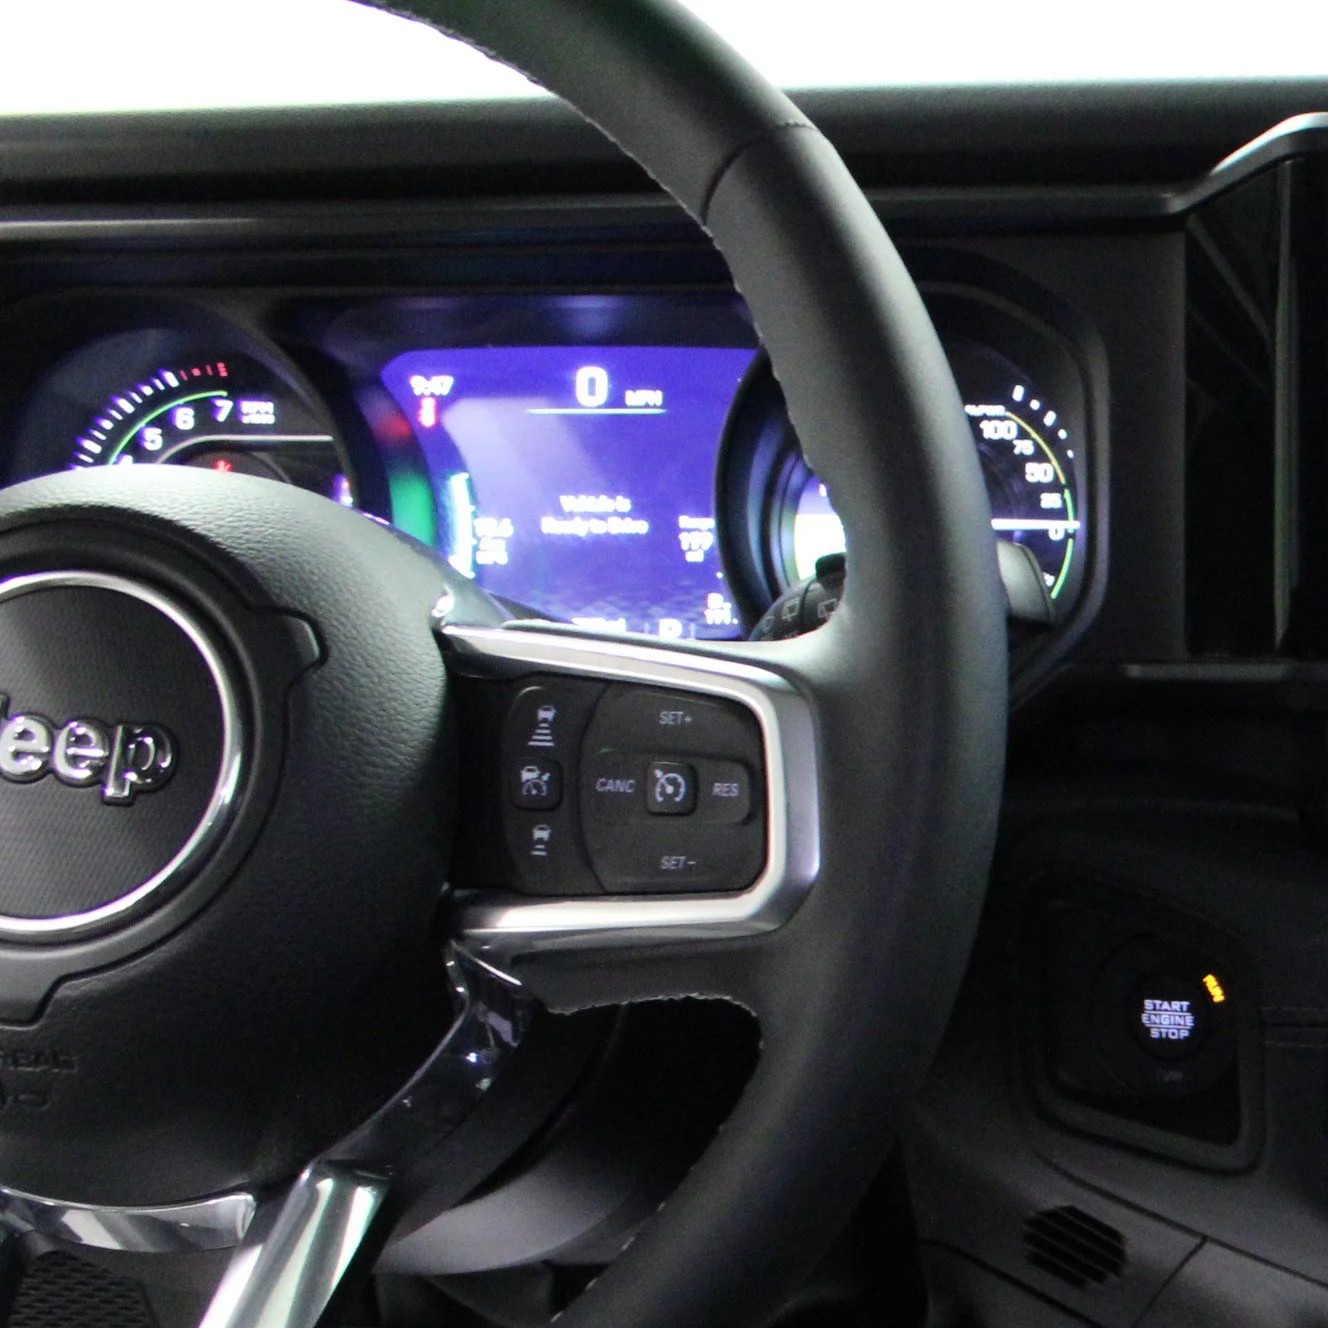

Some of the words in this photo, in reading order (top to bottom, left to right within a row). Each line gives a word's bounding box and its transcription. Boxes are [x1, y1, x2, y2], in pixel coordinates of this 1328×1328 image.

[576, 366, 609, 407] 0
[171, 406, 195, 431] 6
[210, 398, 233, 423] 7
[141, 426, 163, 451] 5
[979, 419, 1018, 441] 100
[1024, 461, 1055, 483] 50
[659, 711, 692, 725] SET+
[0, 705, 178, 801] eep
[596, 778, 636, 794] CANC
[713, 783, 739, 797] RES
[1144, 999, 1190, 1012] START
[1141, 1013, 1194, 1026] ENGINE
[1150, 1028, 1190, 1040] STOP
